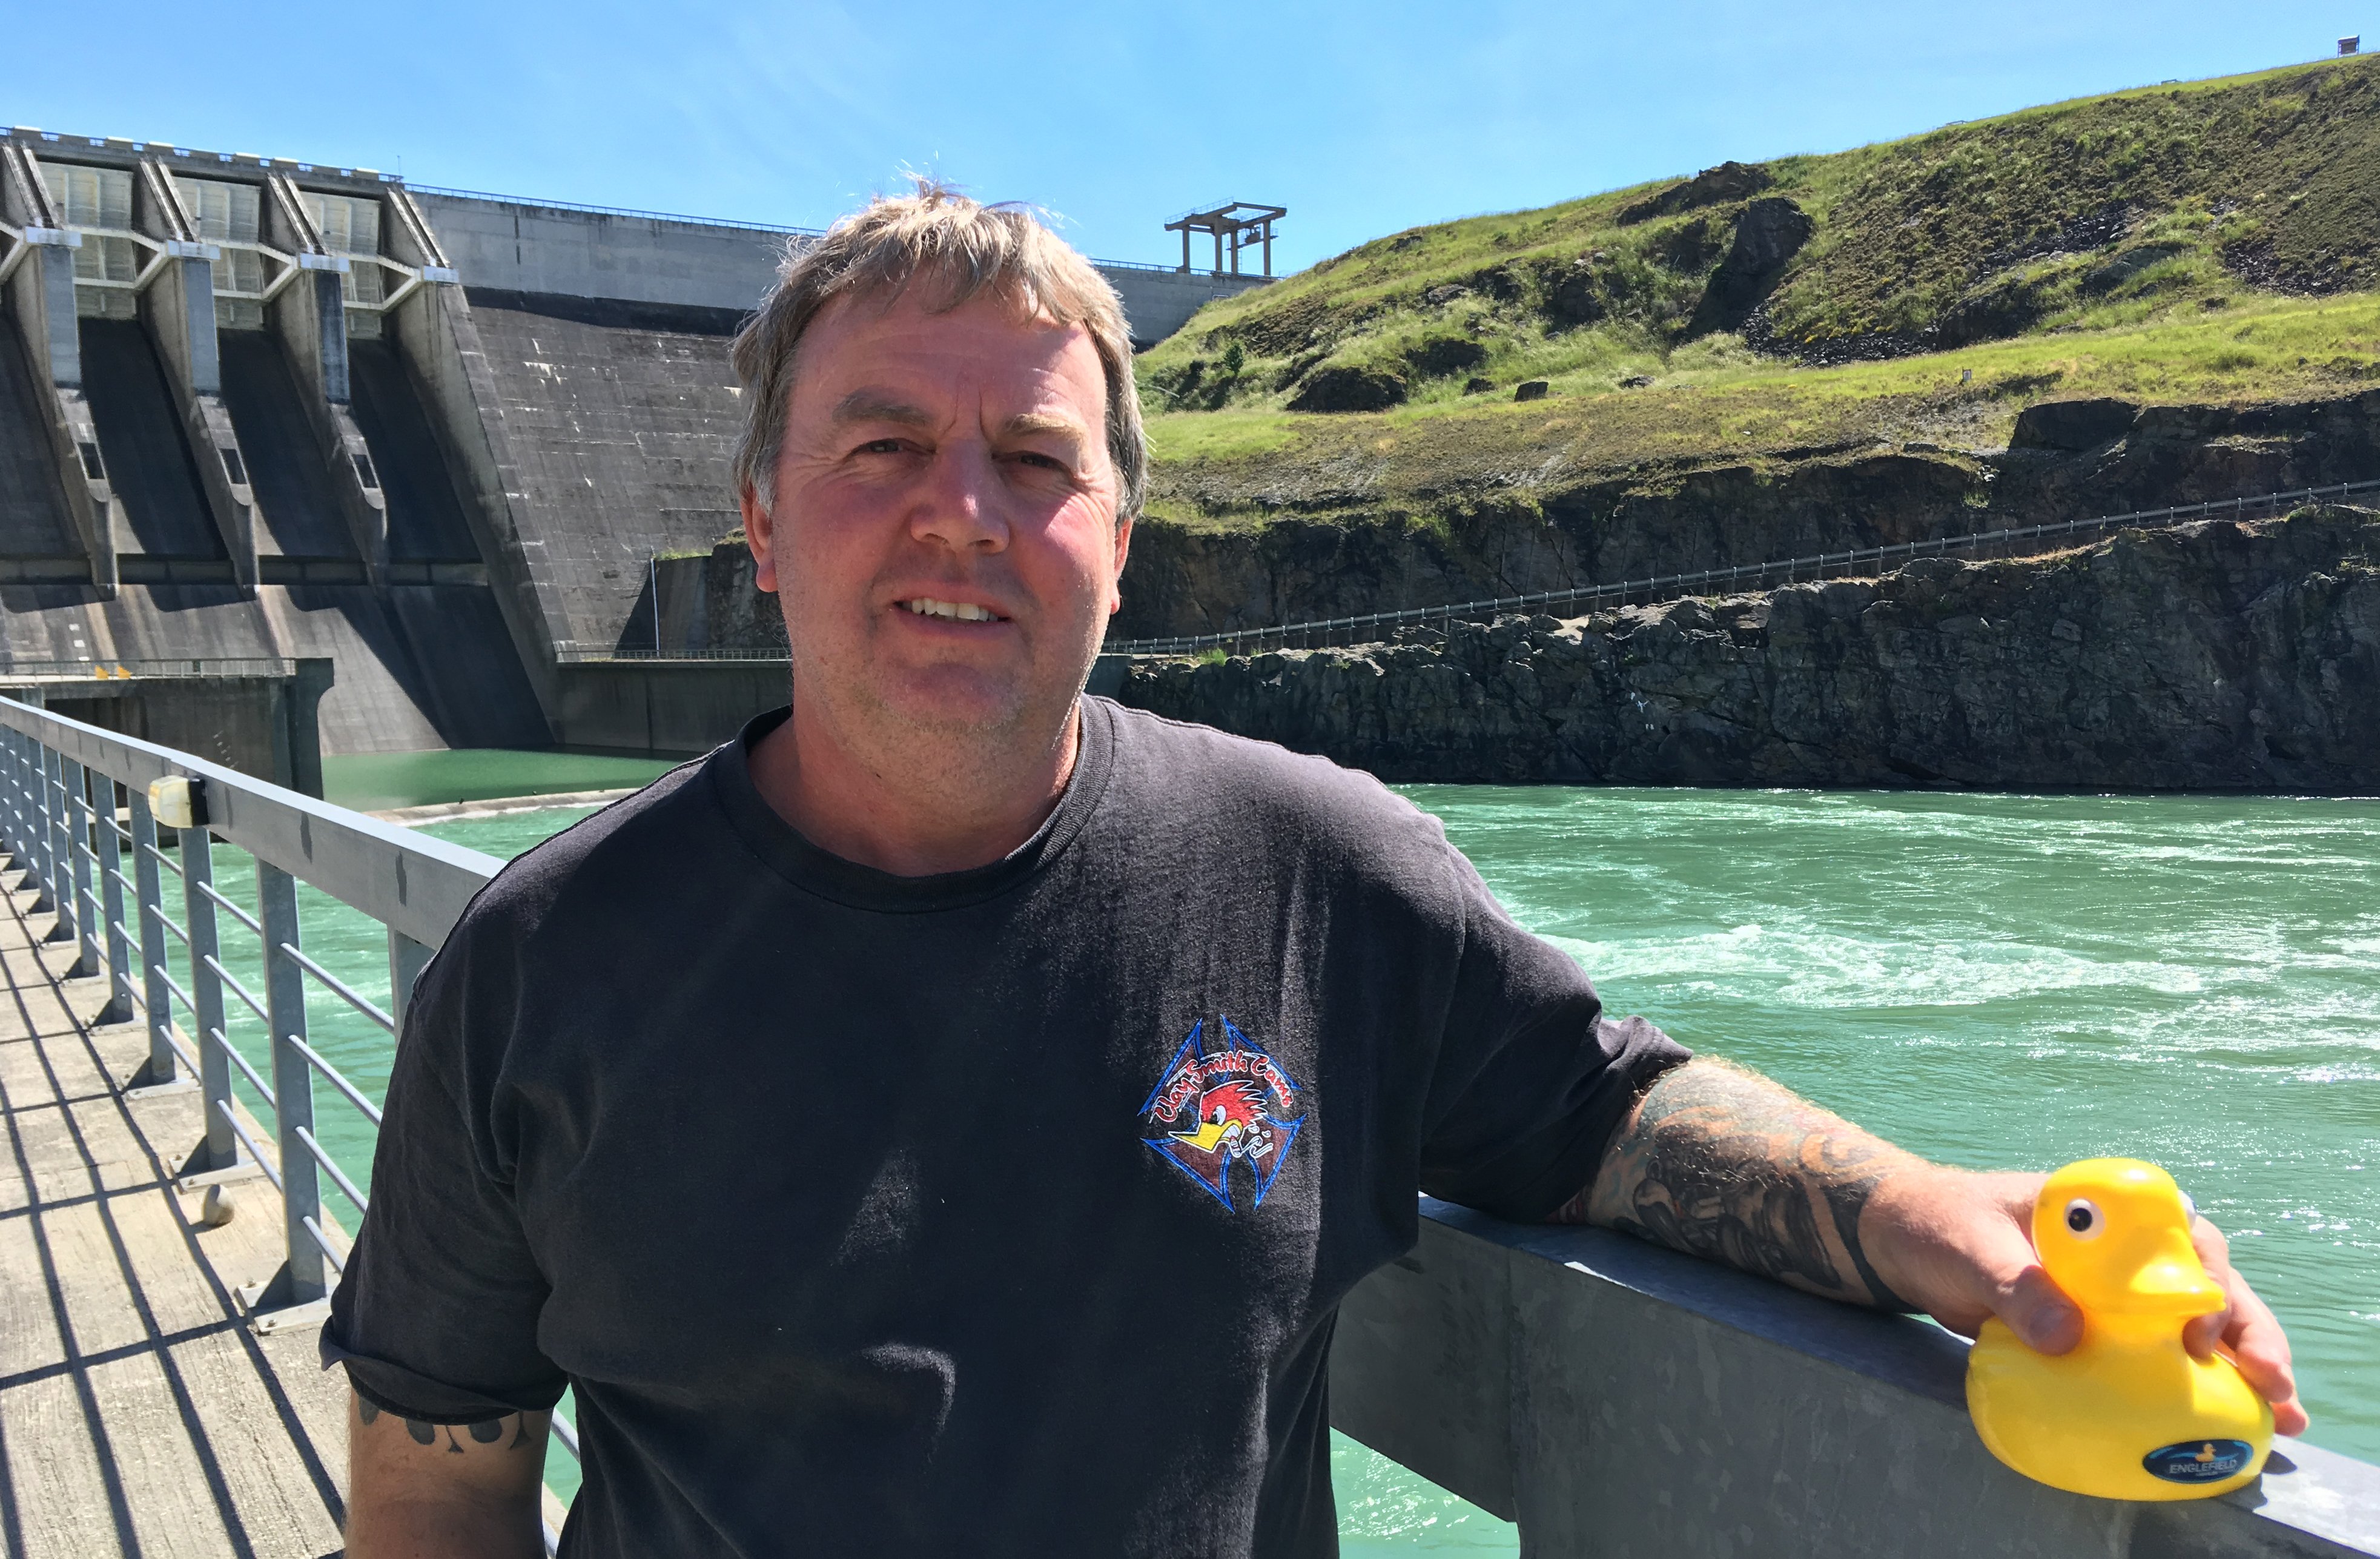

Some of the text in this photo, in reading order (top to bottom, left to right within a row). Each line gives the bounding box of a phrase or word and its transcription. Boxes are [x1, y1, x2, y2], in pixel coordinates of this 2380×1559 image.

[1154, 1050, 1294, 1122] Clay Smith Cams
[2169, 1459, 2237, 1474] ENGLEFIELD
